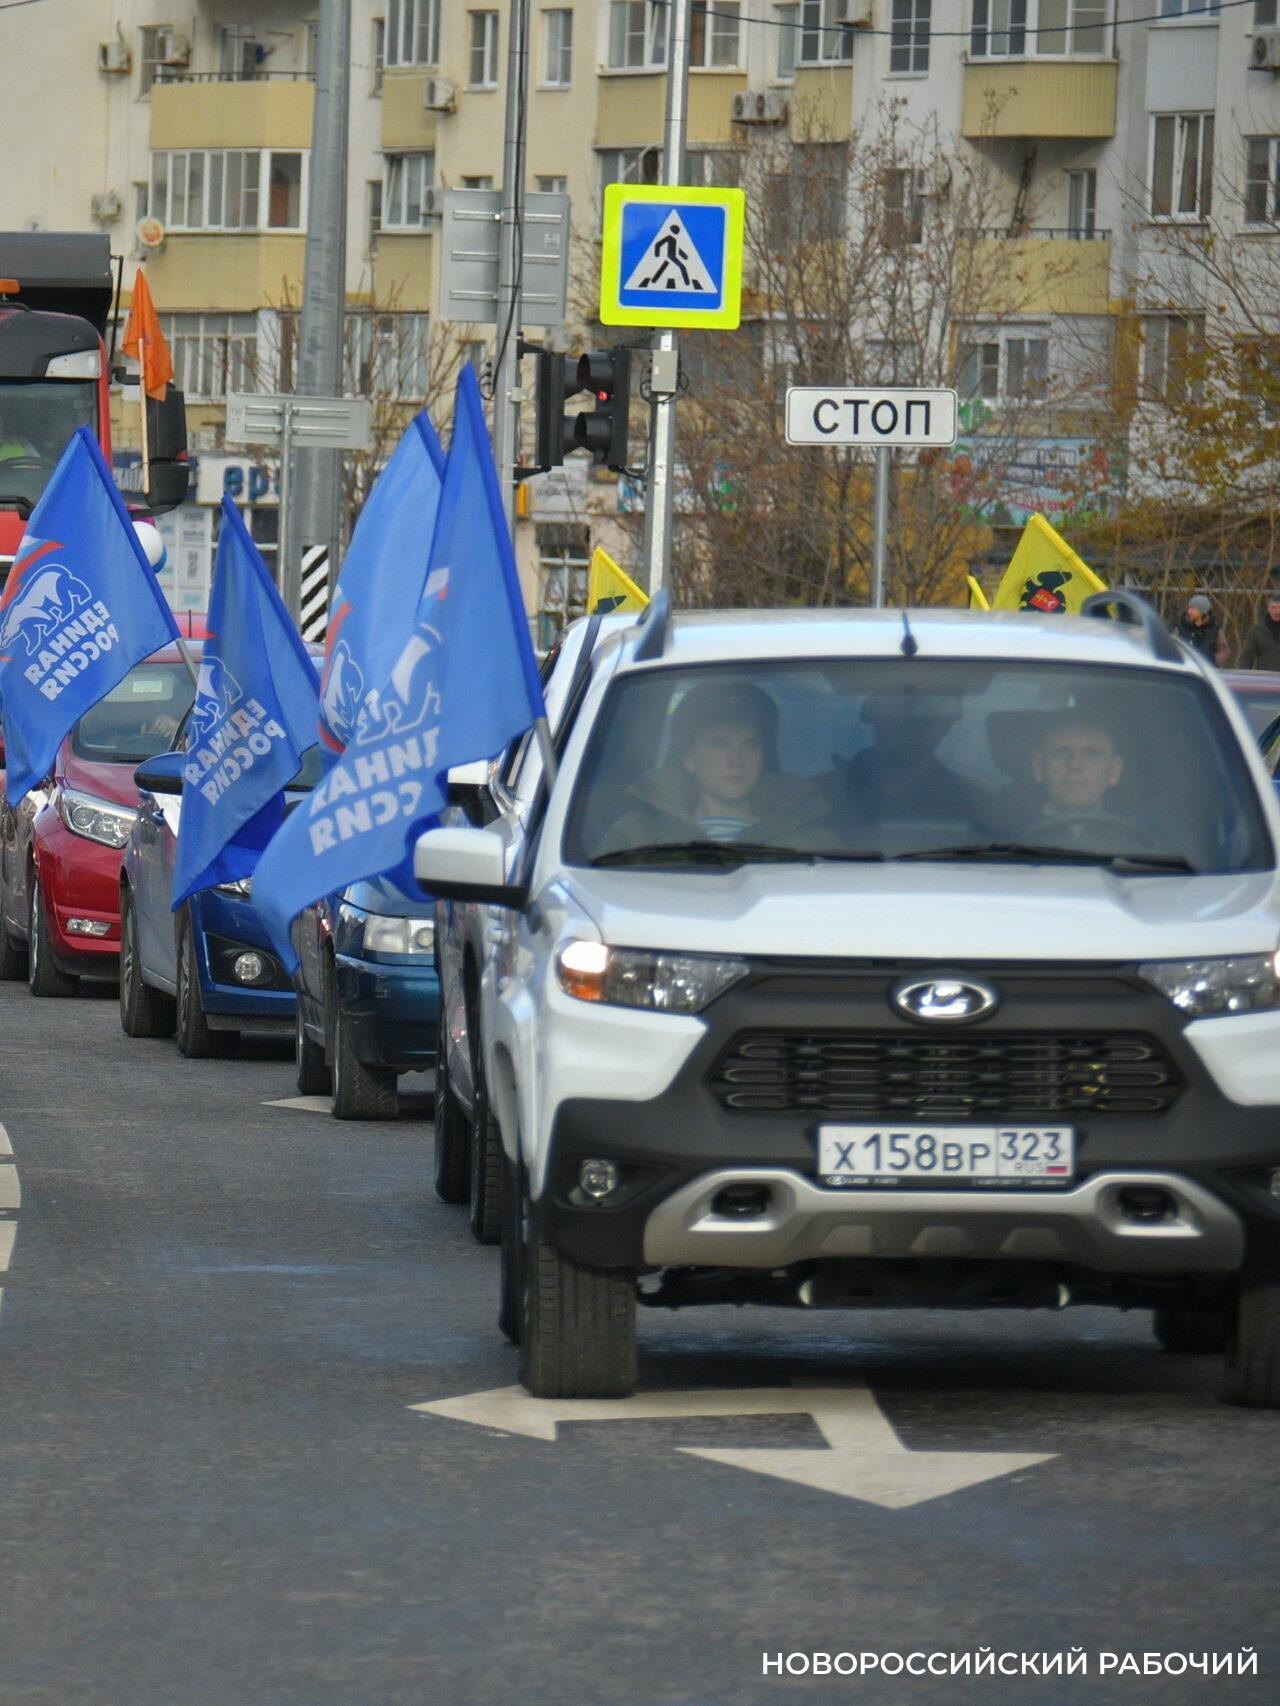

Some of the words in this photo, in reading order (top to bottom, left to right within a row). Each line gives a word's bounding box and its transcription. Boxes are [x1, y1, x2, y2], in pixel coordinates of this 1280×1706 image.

[813, 399, 930, 435] СТОП
[834, 1134, 990, 1171] Х158ВР
[1000, 1132, 1062, 1161] 323
[1015, 1162, 1045, 1173] RUS
